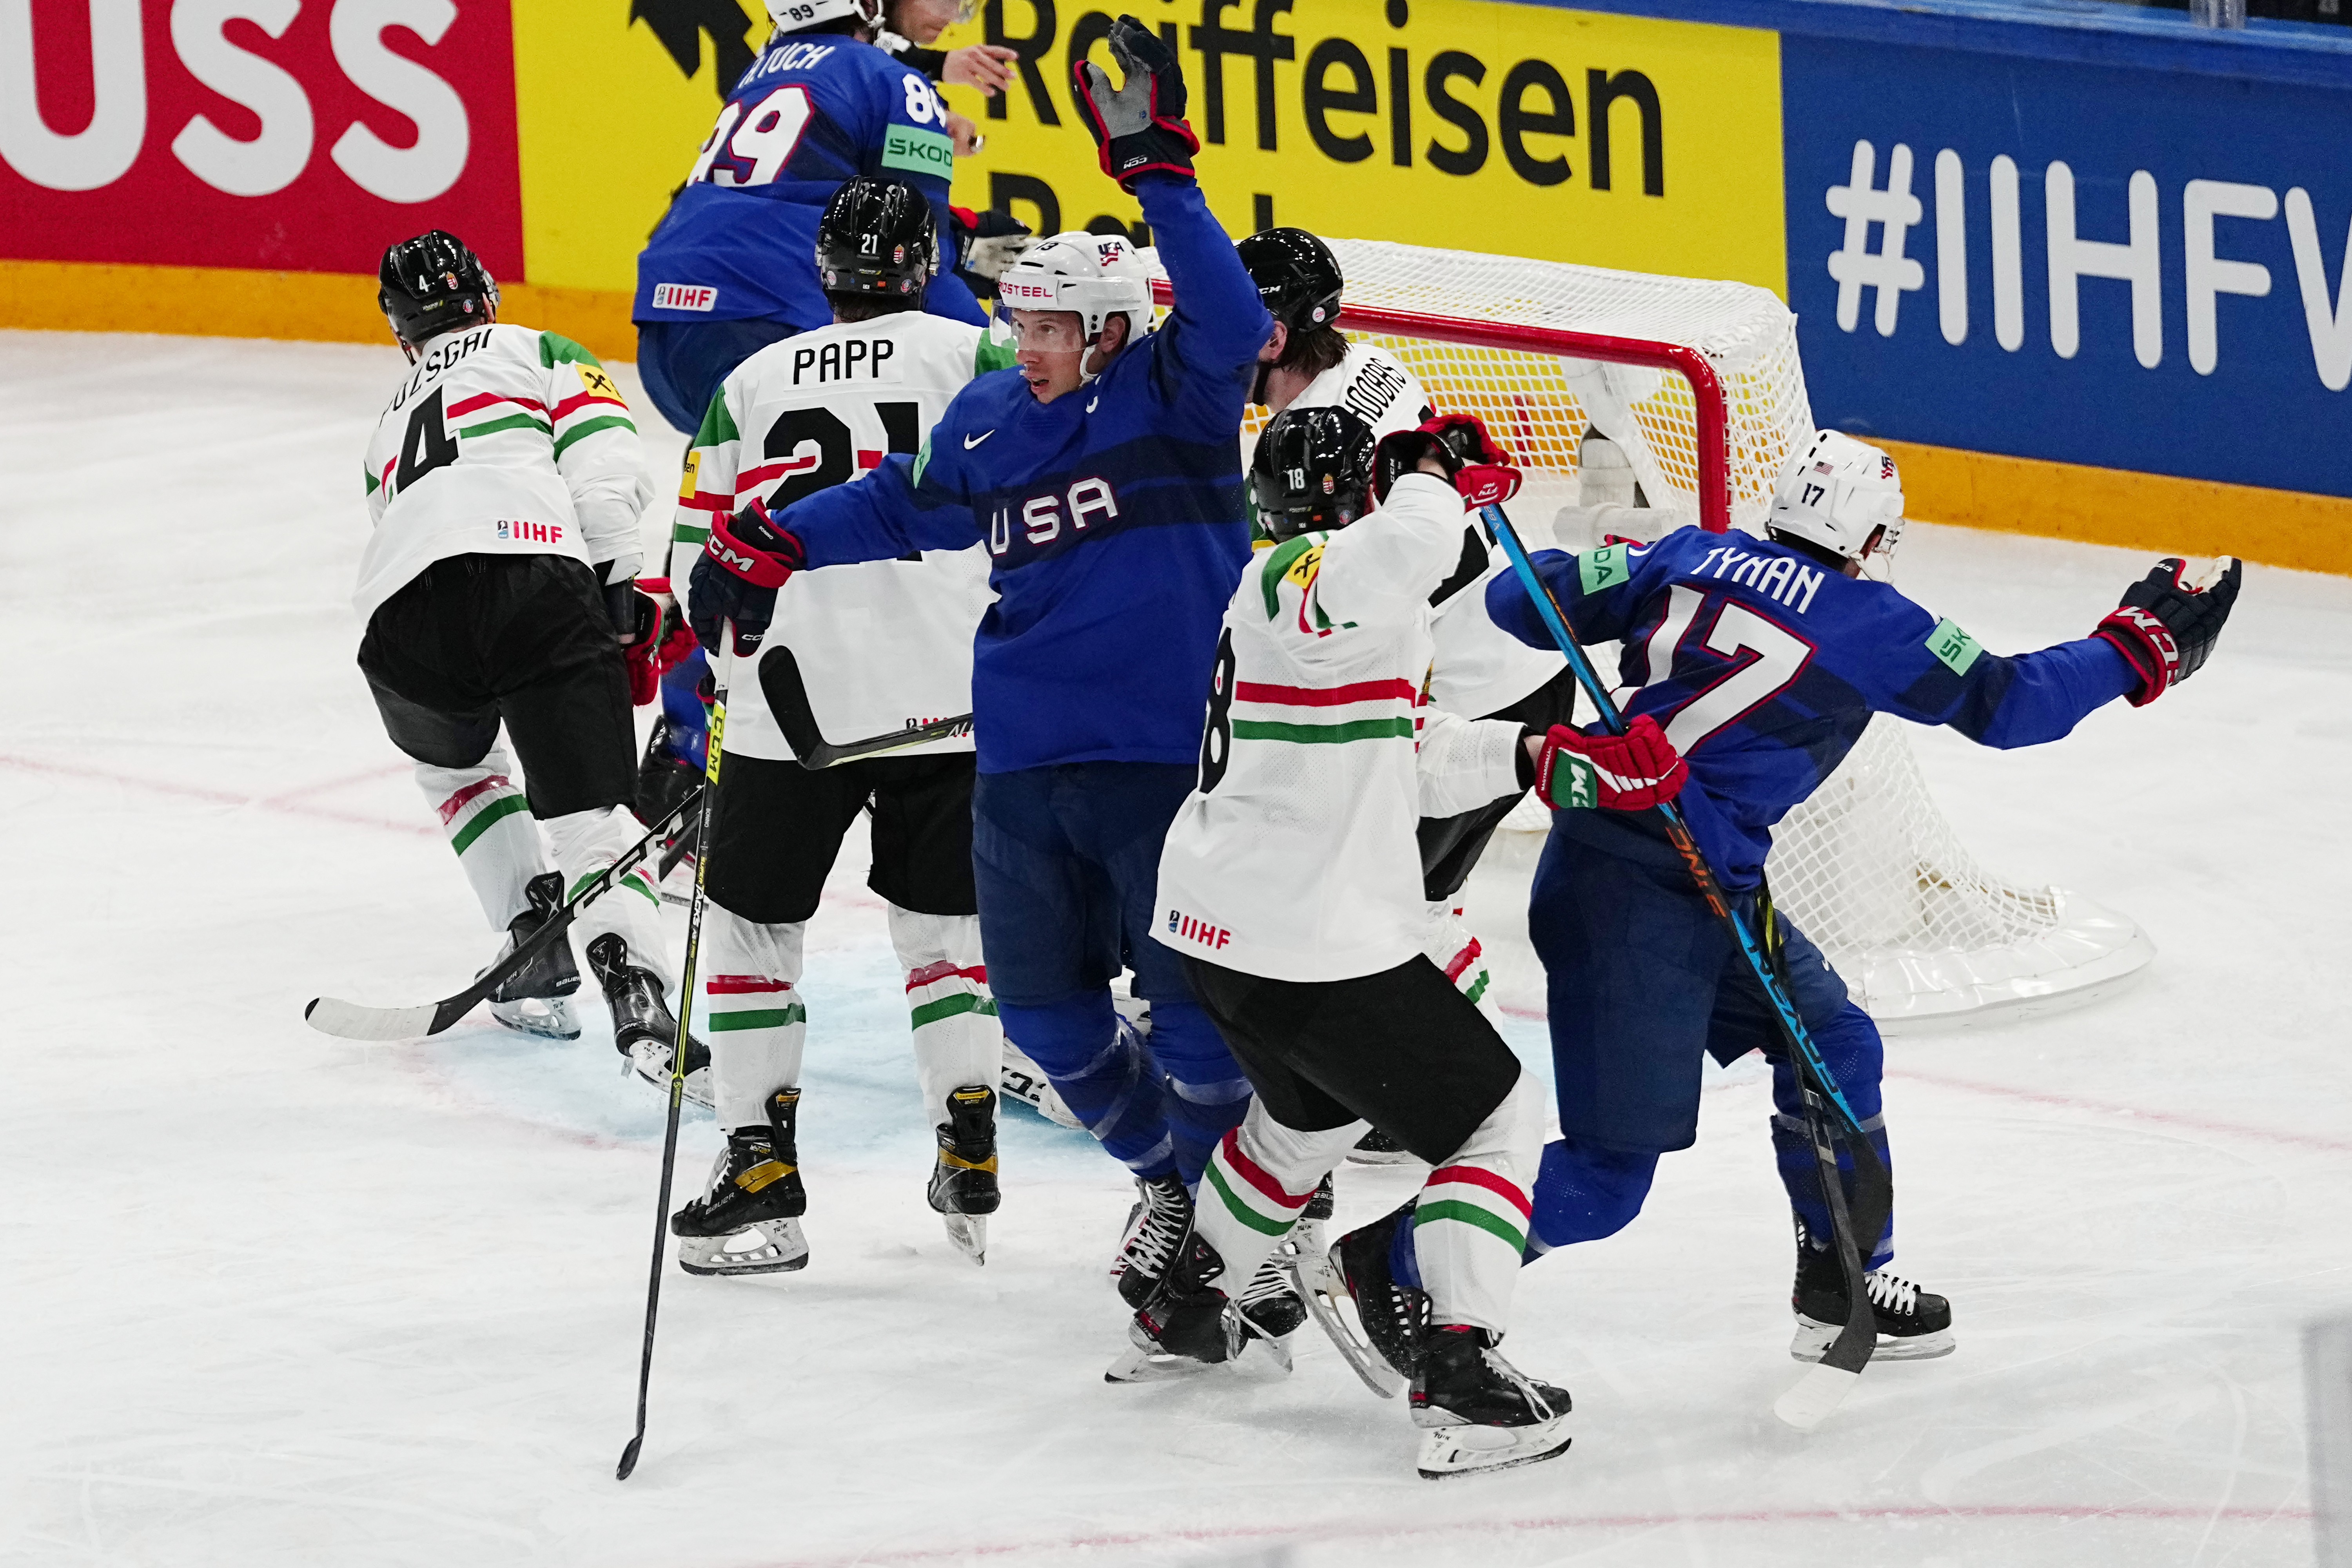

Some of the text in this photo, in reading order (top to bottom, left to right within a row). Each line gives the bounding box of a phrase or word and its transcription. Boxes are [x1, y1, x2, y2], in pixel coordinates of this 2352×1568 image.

[789, 4, 814, 21] 89
[0, 0, 469, 203] USS
[861, 234, 878, 254] 21
[419, 275, 429, 292] 4
[666, 287, 711, 307] IIHF
[793, 339, 893, 385] PAPP
[396, 384, 459, 495] 4
[764, 402, 923, 562] 21
[1287, 468, 1305, 490] 18
[1801, 482, 1825, 507] 17
[513, 520, 563, 544] IIHF
[758, 526, 774, 540] BONINO
[992, 477, 1118, 556] USA
[707, 534, 755, 572] CM
[1691, 547, 1824, 614] TYNAN
[1609, 583, 1817, 756] 17
[709, 715, 723, 773] CCM
[573, 812, 684, 918] CCM
[693, 883, 705, 928] TACKS
[1181, 915, 1231, 950] IIHF
[555, 976, 581, 988] BAUER
[705, 1191, 735, 1215] BAUER
